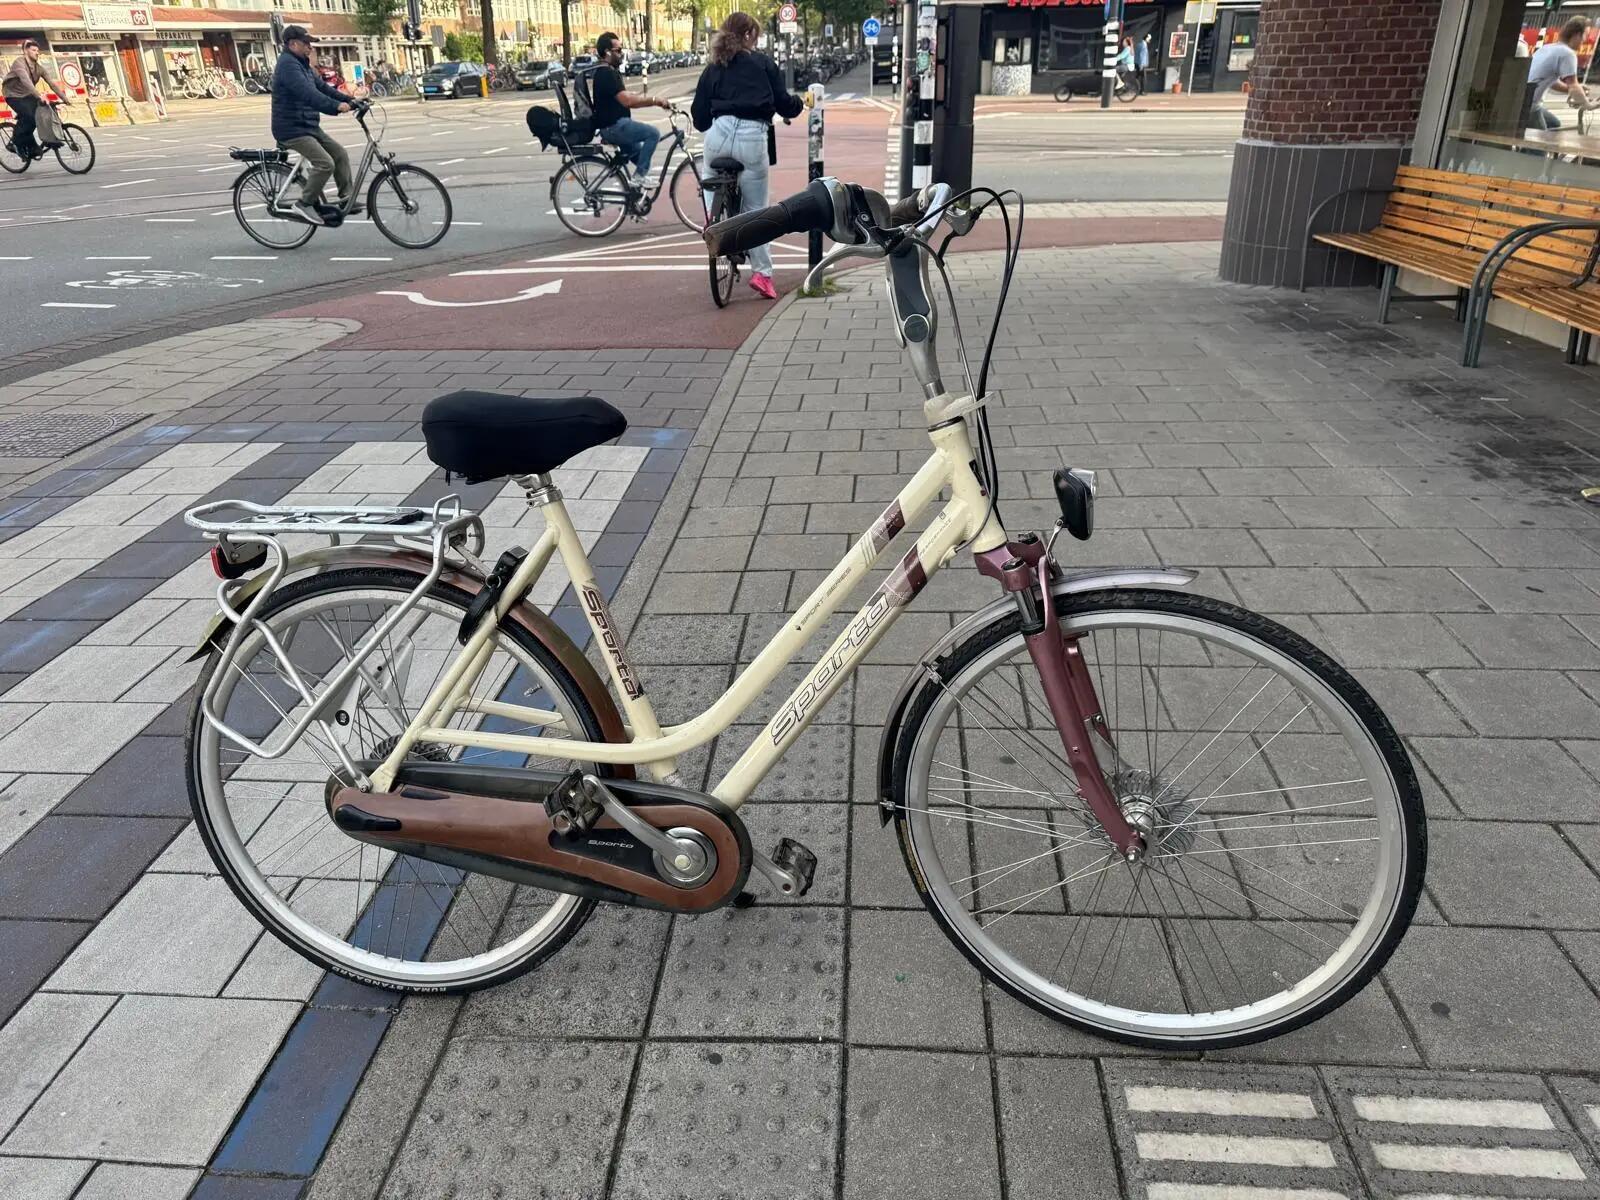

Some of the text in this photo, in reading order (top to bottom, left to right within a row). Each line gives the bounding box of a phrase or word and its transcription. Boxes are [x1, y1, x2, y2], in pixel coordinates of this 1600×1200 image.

[783, 9, 793, 17] 30
[156, 32, 193, 40] REPARATIE
[800, 567, 852, 626] SPORT SERIES
[771, 592, 890, 746] Sparta
